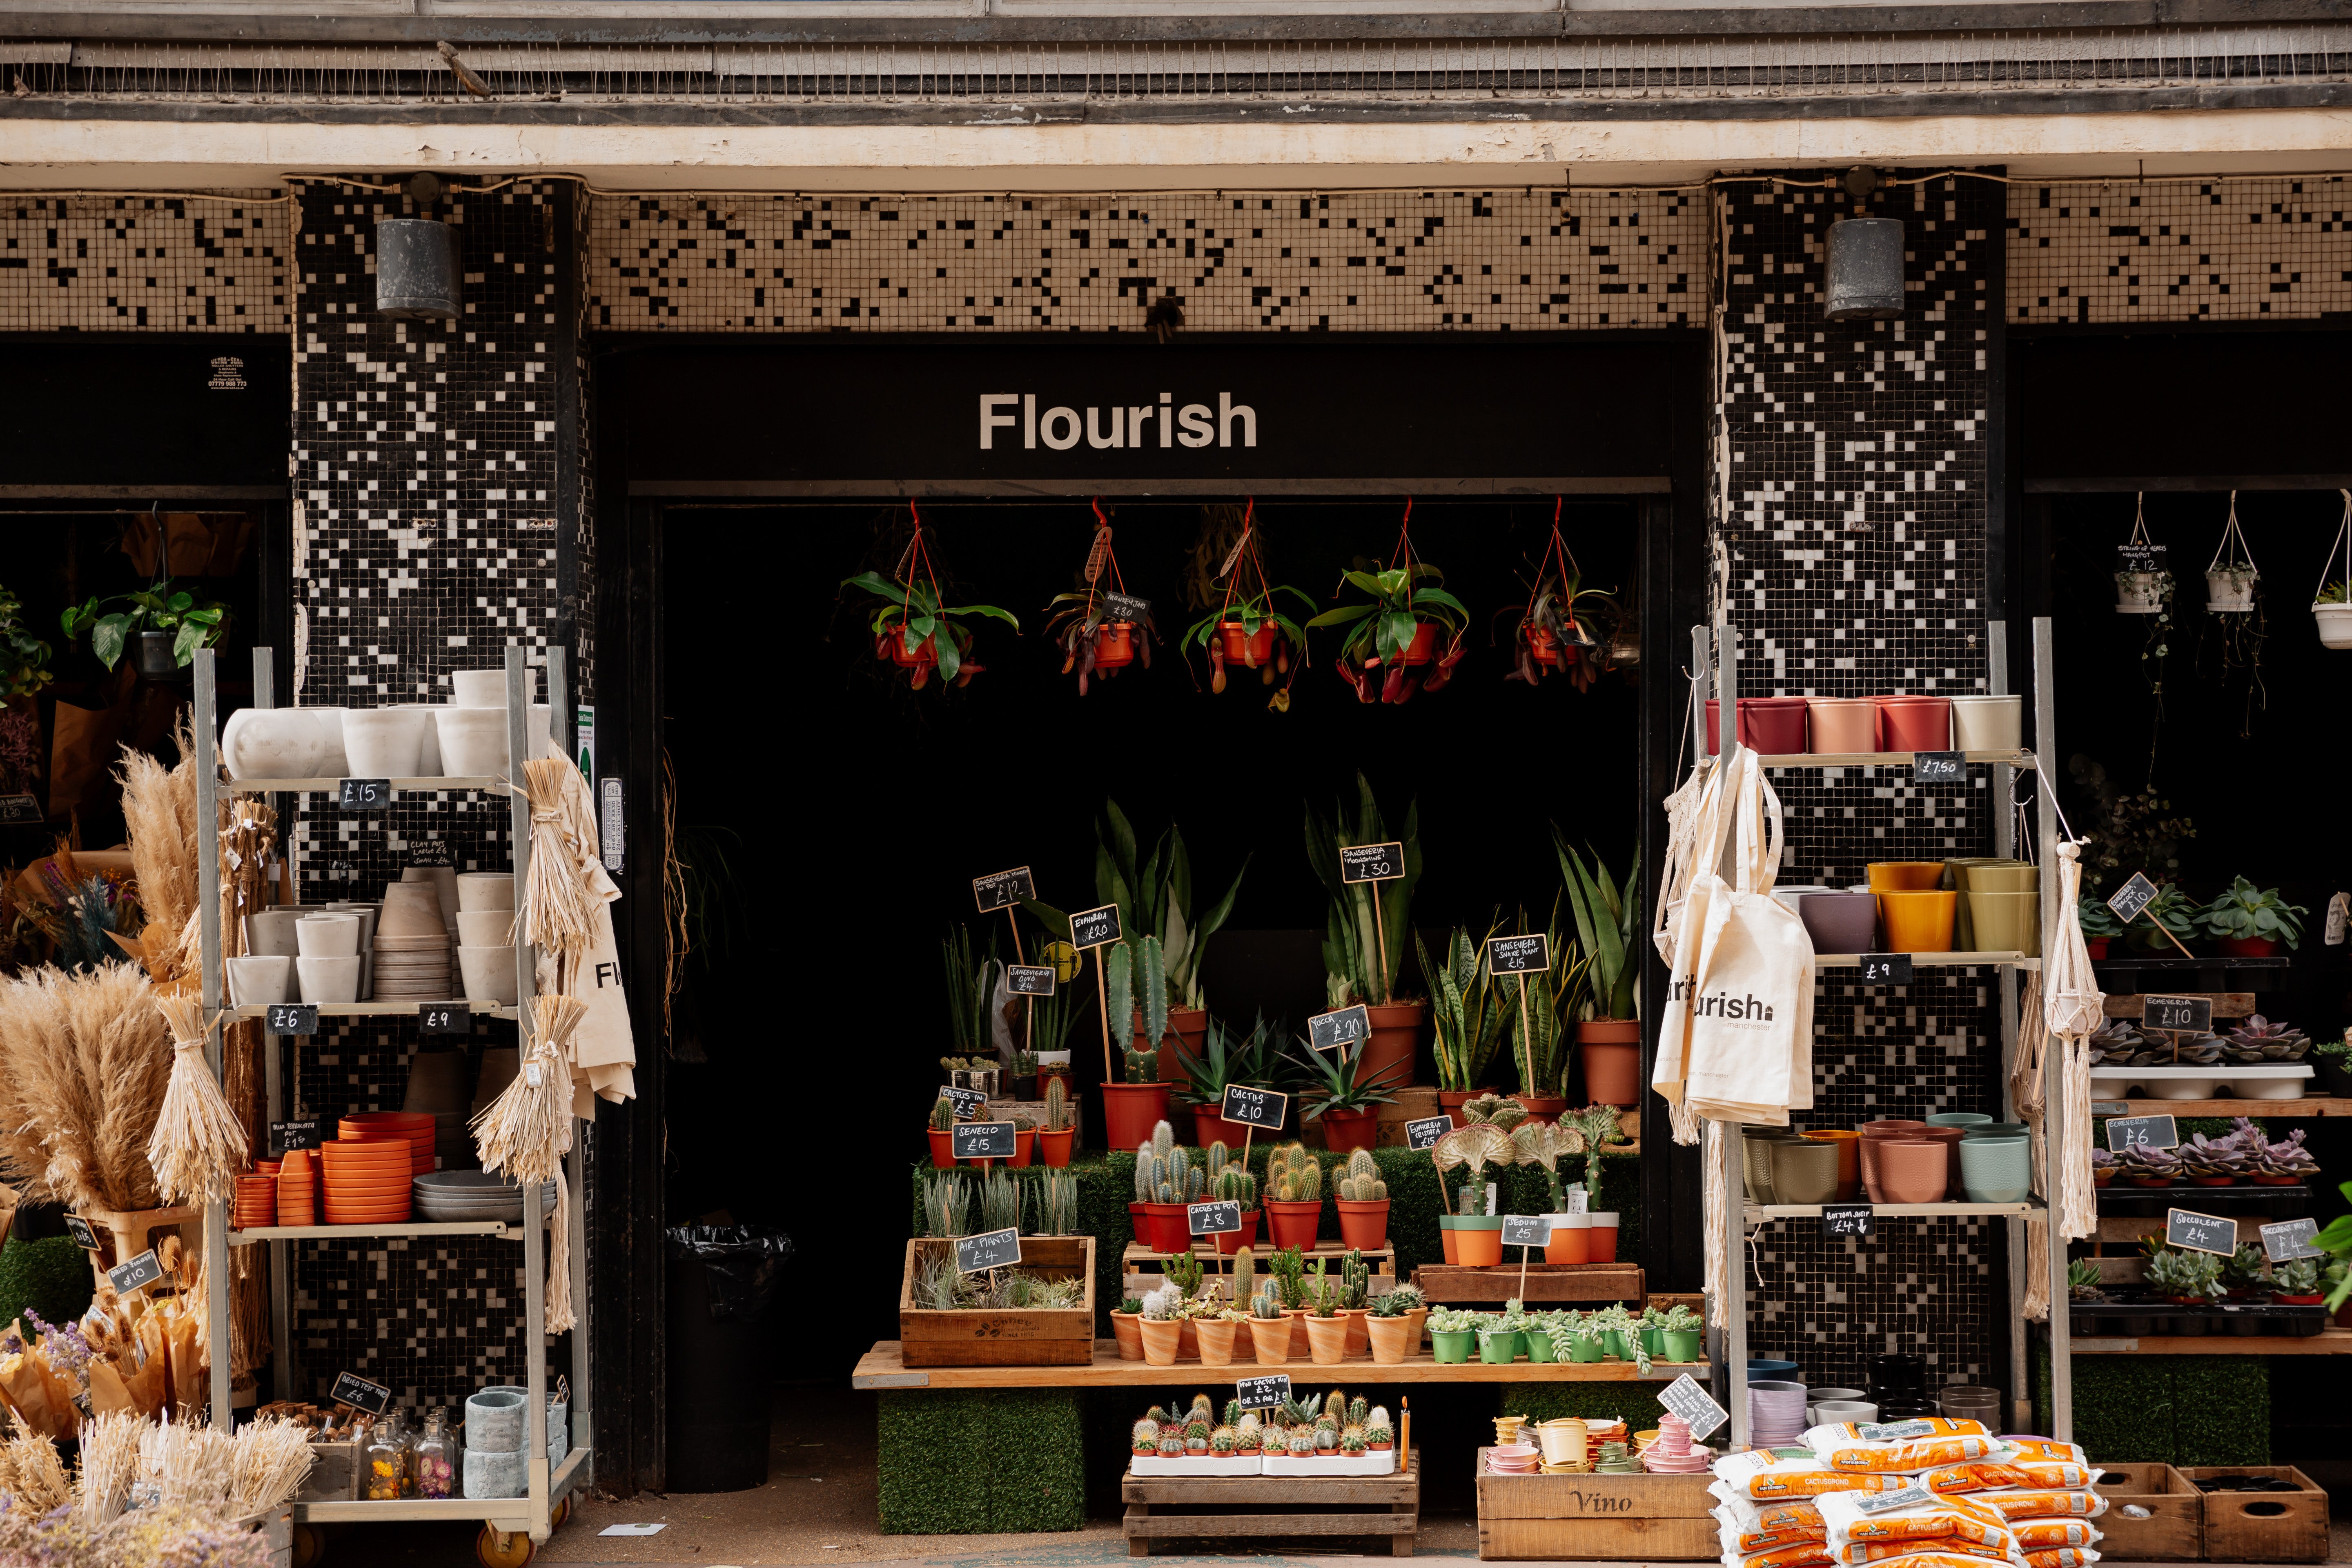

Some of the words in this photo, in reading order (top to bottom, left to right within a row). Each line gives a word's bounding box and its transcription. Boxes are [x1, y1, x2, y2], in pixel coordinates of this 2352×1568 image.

[980, 392, 1256, 450] Flourish
[1107, 594, 1134, 606] MONKEY
[1114, 606, 1133, 616] £30
[343, 784, 376, 803] £15
[1361, 862, 1390, 878] £30
[2127, 891, 2148, 912] £10
[1075, 911, 1107, 928] EUPHORBIA
[1088, 924, 1107, 940] £20
[1499, 950, 1519, 959] SNAKE
[1521, 947, 1539, 956] PLANT
[1508, 957, 1525, 969] £15
[1866, 964, 1889, 980] £9
[1019, 982, 1033, 992] £4
[2147, 997, 2192, 1006] ECHEVERIA
[275, 1010, 297, 1027] £6
[428, 1012, 448, 1026] £9
[1310, 1015, 1335, 1030] YUCCA
[2162, 1006, 2191, 1025] £10
[1333, 1018, 1361, 1042] £20
[1727, 1022, 1771, 1031] manchester
[943, 1089, 970, 1100] CACTUS
[1231, 1088, 1263, 1104] CACTUS
[1237, 1104, 1261, 1120] £10
[1409, 1121, 1441, 1134] EUPHORBIA
[2109, 1118, 2149, 1128] ECHEVERIA
[959, 1127, 998, 1137] SENECIO
[1415, 1128, 1441, 1138] CRISTATA
[2125, 1127, 2149, 1146] £6
[967, 1138, 989, 1151] £15
[1421, 1136, 1435, 1147] £15
[1190, 1204, 1212, 1214] CACTUS
[1223, 1203, 1238, 1211] POT
[1826, 1211, 1852, 1220] BOTTOM
[1203, 1213, 1225, 1229] £8
[1508, 1218, 1537, 1226] SEDUM
[1834, 1220, 1853, 1233] £4
[2176, 1213, 2224, 1229] SUCCULENT
[2261, 1224, 2293, 1235] SUCCULENT
[2294, 1221, 2307, 1231] MIX
[1516, 1227, 1532, 1239] £5
[2186, 1227, 2208, 1243] £4
[960, 1240, 975, 1252] AIR
[2279, 1235, 2303, 1257] £4
[973, 1250, 998, 1265] £4
[110, 1266, 128, 1278] DRIED
[342, 1375, 360, 1387] DRIED
[361, 1383, 375, 1391] TEST
[1256, 1385, 1272, 1394] £2
[347, 1390, 363, 1401] £6
[1666, 1389, 1685, 1410] MEDIUM
[1681, 1376, 1697, 1393] ZINC
[1697, 1392, 1713, 1409] POTS
[1661, 1394, 1678, 1413] LARGE
[1688, 1395, 1701, 1409] ZINC
[1887, 1450, 1930, 1462] CACTUSGROND
[1949, 1447, 1958, 1455] 5L
[1867, 1480, 1876, 1488] 5L
[1570, 1490, 1633, 1512] Vino
[1908, 1521, 1952, 1531] CACTUSGROND
[1968, 1528, 1976, 1537] 5L
[1872, 1548, 1883, 1556] 5L
[1902, 1546, 1950, 1555] CACTUSGROND
[2044, 1557, 2053, 1565] 5L
